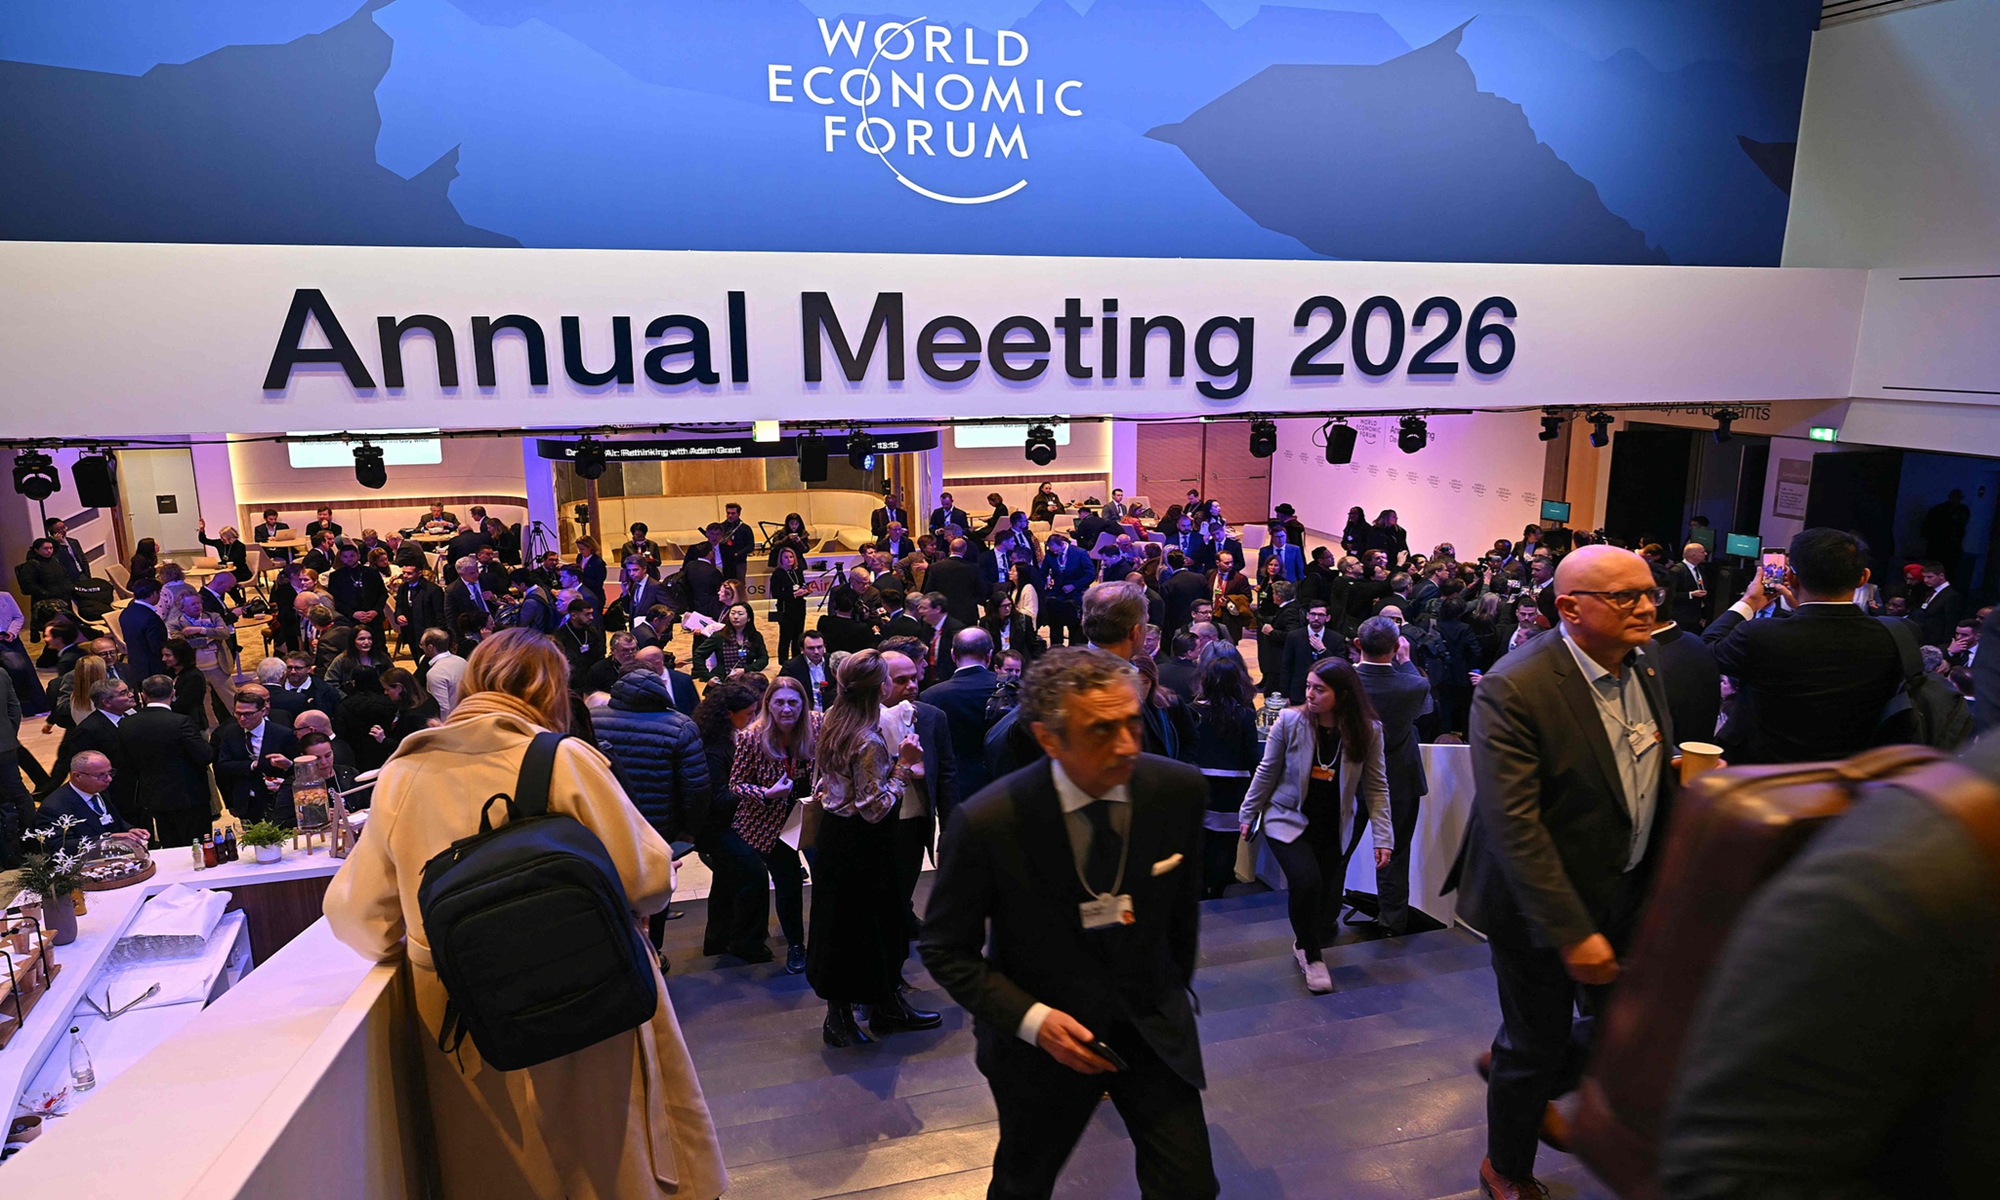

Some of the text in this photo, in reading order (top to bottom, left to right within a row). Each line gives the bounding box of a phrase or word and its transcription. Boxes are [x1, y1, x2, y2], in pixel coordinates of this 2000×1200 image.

[817, 18, 1029, 67] WORLD
[768, 64, 1083, 117] ECONOMIC
[825, 115, 1029, 159] FORUM
[262, 288, 1518, 400] Annual Meeting 2026
